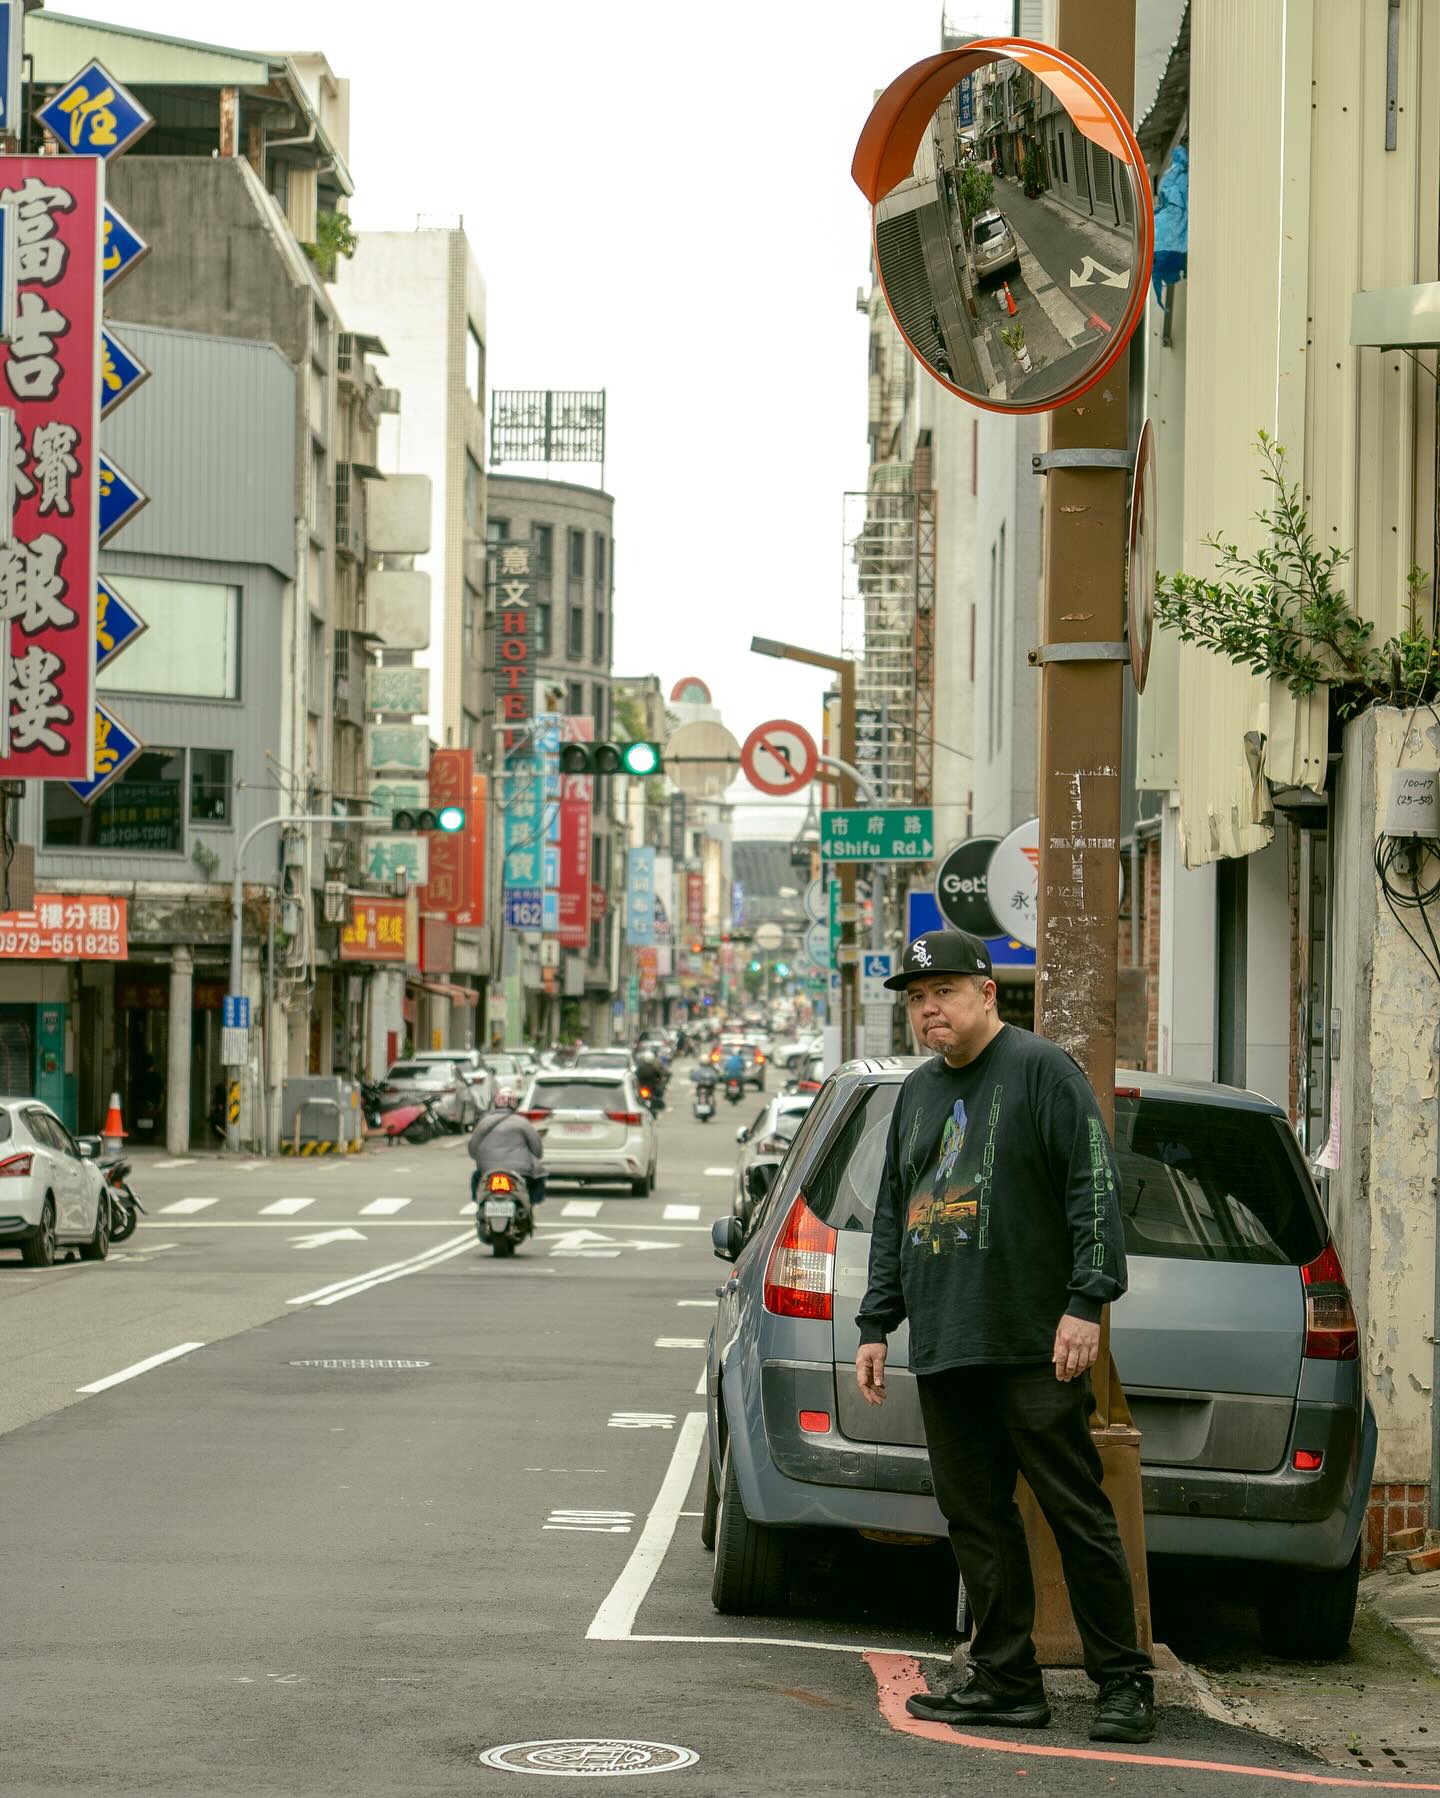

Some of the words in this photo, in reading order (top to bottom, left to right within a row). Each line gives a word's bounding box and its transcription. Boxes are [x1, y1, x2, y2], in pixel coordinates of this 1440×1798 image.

[500, 611, 528, 749] HOTEL
[1403, 779, 1433, 789] 100-17
[831, 815, 922, 835] 市府路
[833, 840, 880, 856] Shifu
[892, 840, 922, 856] Rd.
[1011, 890, 1037, 910] 永
[512, 903, 541, 924] 162
[911, 940, 932, 968] Sox
